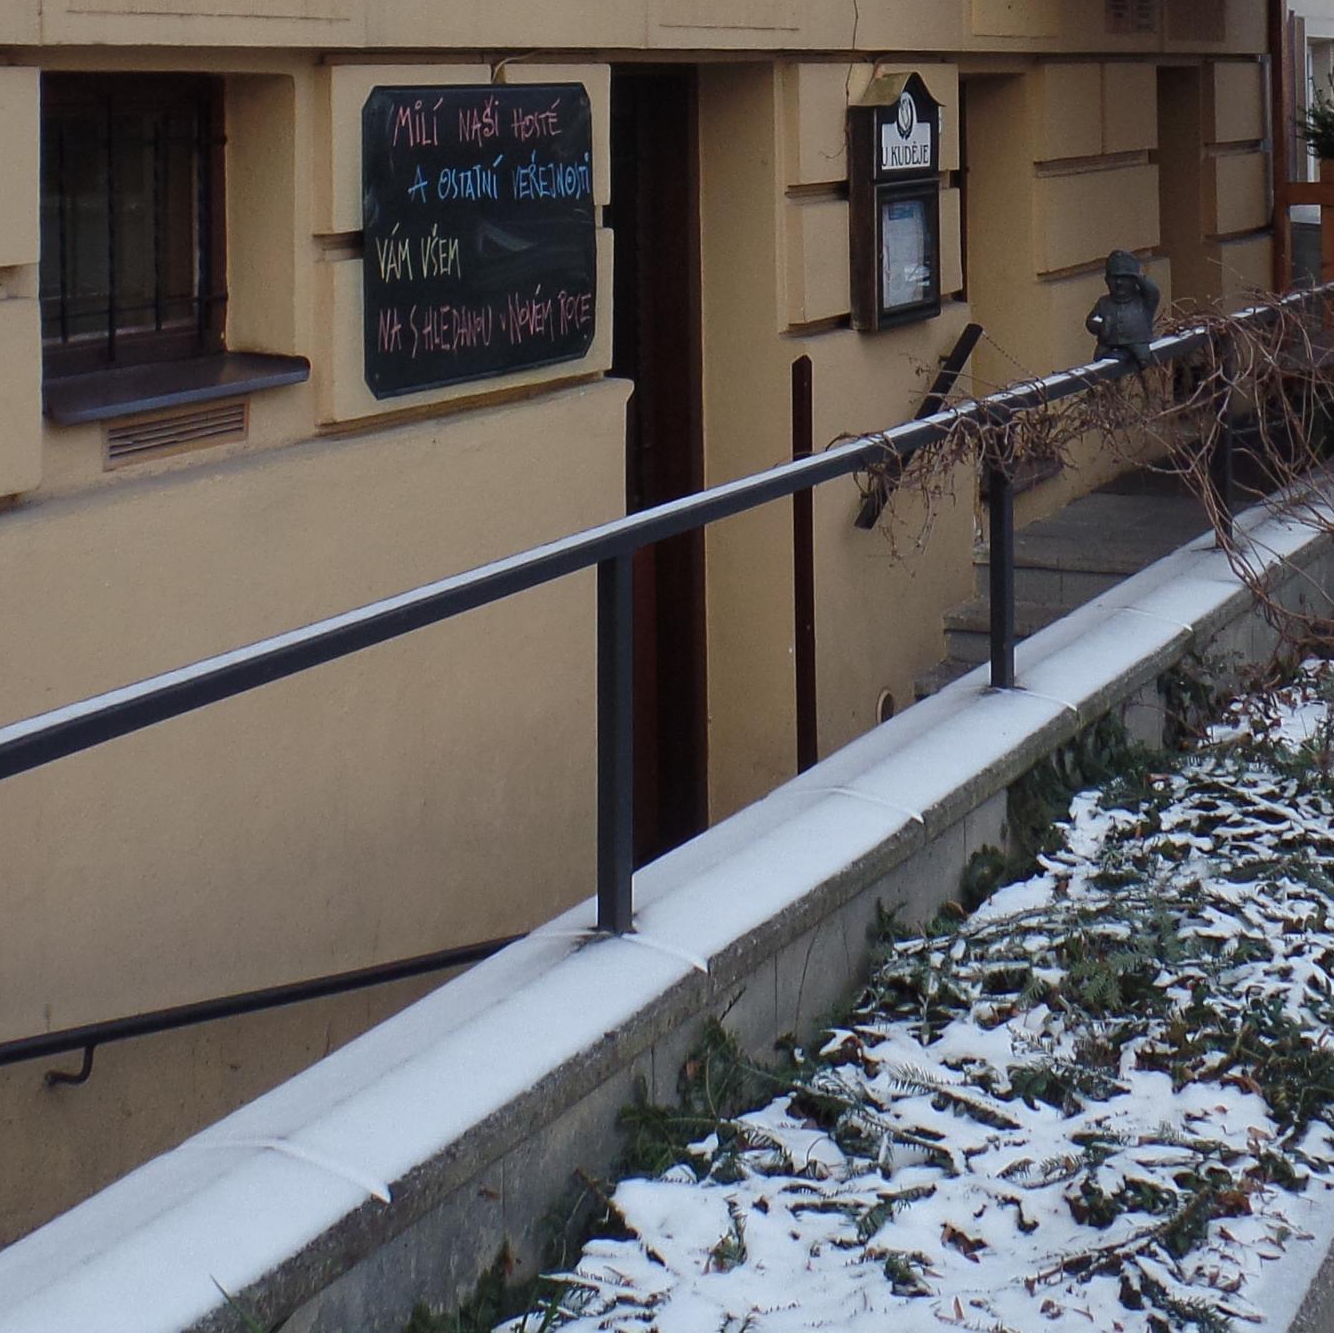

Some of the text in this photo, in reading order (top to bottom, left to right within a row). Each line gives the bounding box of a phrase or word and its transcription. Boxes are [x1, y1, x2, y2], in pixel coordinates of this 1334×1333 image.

[511, 98, 562, 141] HOSTÉ
[891, 141, 929, 167] KUDĚJE
[407, 164, 428, 202] A
[437, 154, 504, 200] OSTATNÍ
[376, 222, 461, 282] VÁM VŠEM
[557, 289, 592, 335] ROCE
